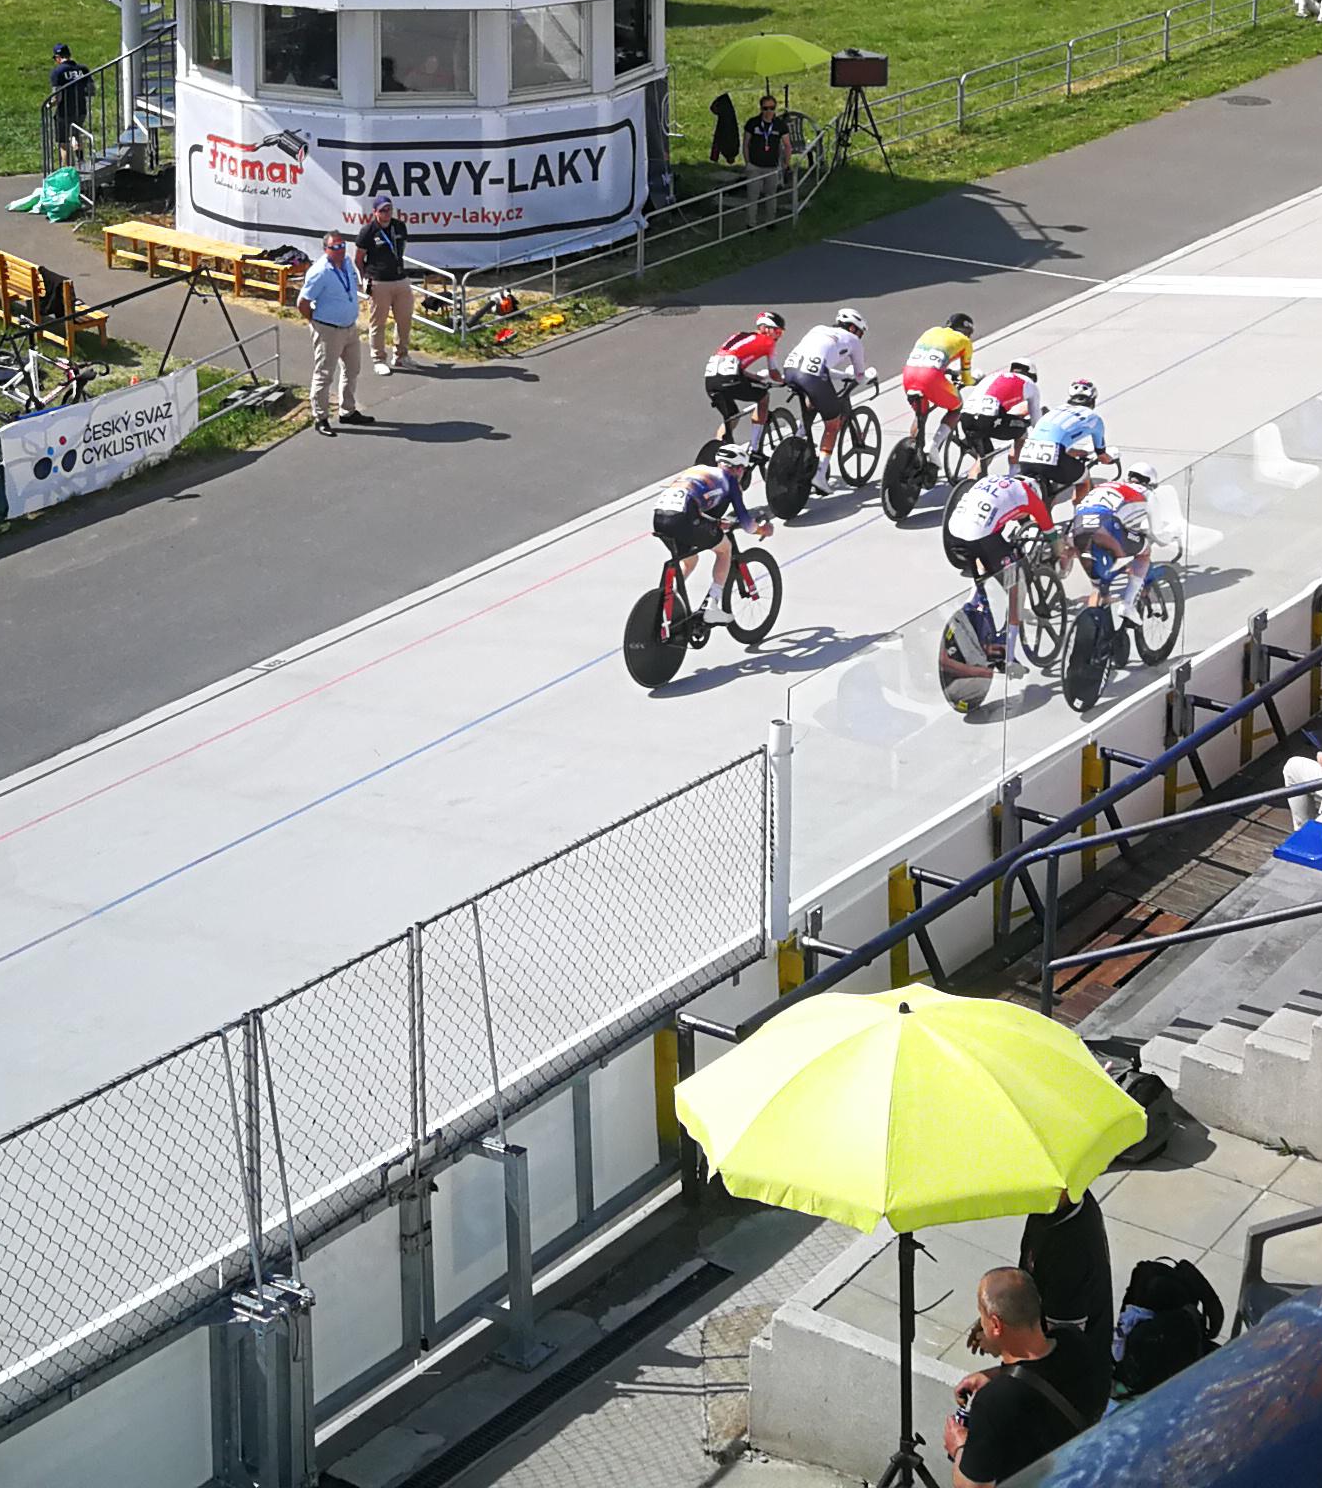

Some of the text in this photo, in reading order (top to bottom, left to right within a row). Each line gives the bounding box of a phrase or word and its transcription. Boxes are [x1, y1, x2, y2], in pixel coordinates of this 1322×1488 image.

[207, 134, 304, 185] Framar
[341, 146, 607, 197] BARVY-LAKY
[83, 402, 174, 444] ČESKÝ SVAZ
[82, 425, 167, 465] CYKLISTIKY
[1036, 444, 1054, 462] 51
